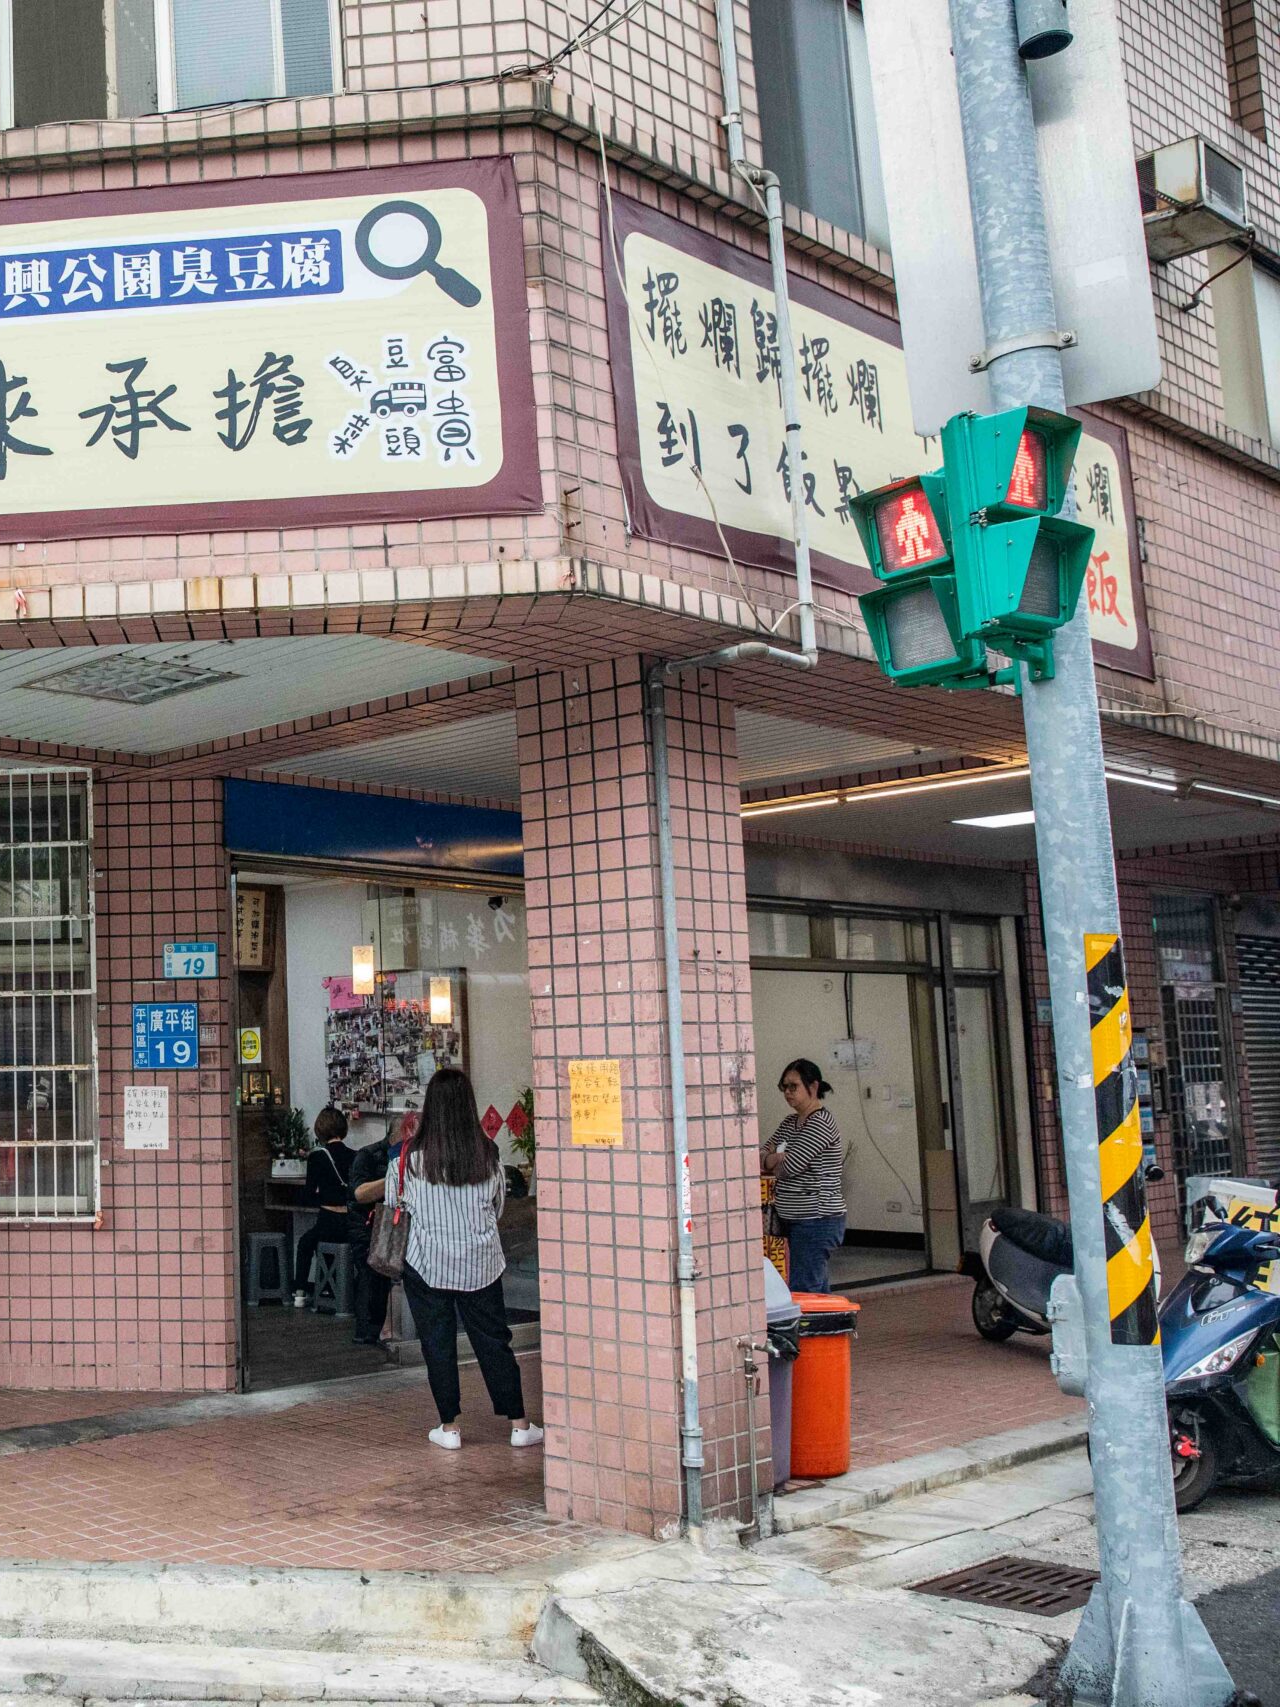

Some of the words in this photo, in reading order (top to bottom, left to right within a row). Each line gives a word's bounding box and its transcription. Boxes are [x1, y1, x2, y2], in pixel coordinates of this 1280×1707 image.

[183, 957, 205, 976] 19
[135, 1008, 147, 1048] 平鎮區
[150, 1008, 195, 1032] 廣平街
[155, 1040, 191, 1064] 19
